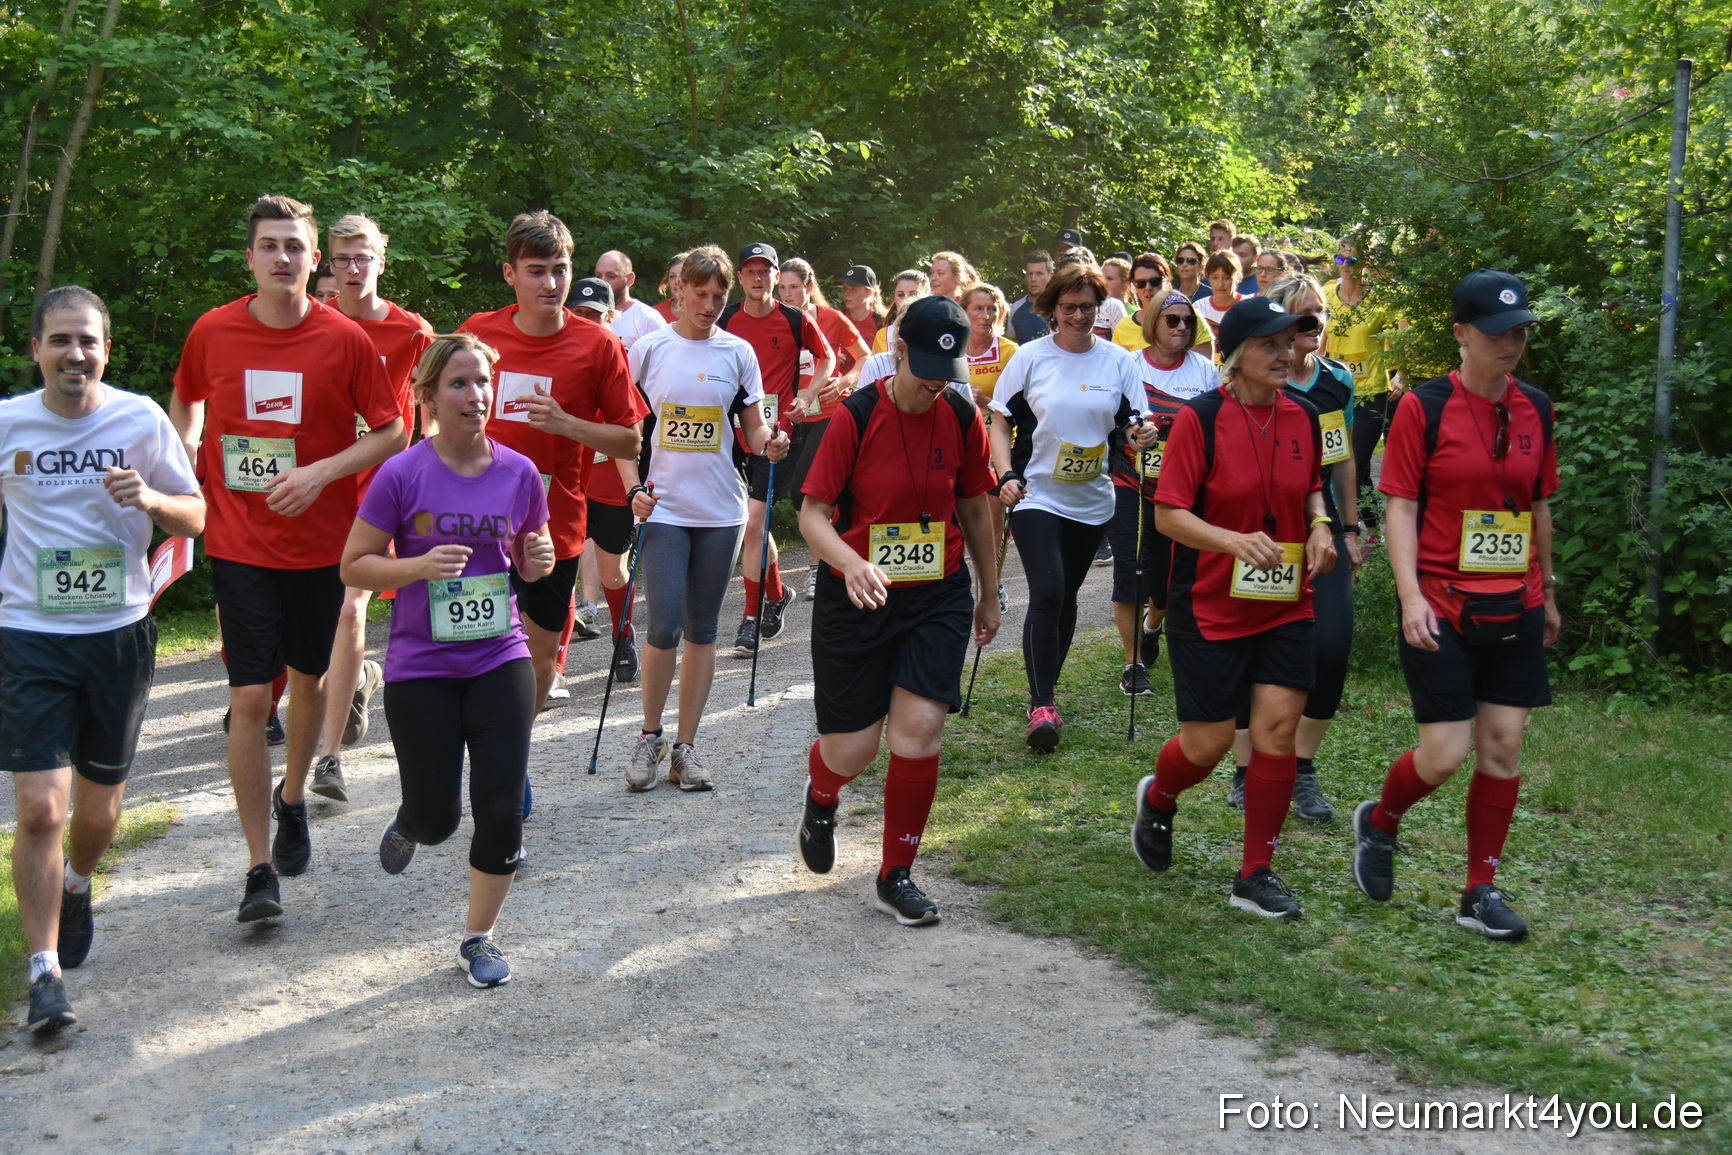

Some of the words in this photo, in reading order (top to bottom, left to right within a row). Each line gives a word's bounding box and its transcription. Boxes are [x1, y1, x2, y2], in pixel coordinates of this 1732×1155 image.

[975, 366, 1002, 375] BÖGL
[1347, 362, 1363, 373] 91
[266, 400, 284, 409] DEHN
[667, 420, 714, 439] 2379
[1518, 434, 1531, 449] 13
[934, 448, 943, 463] 3
[238, 456, 280, 477] 464
[1061, 457, 1100, 473] 2371
[1469, 532, 1523, 555] 2353
[878, 543, 935, 565] 2348
[55, 569, 107, 594] 942
[1241, 562, 1294, 585] 2364
[84, 591, 117, 600] Christoph
[448, 597, 495, 623] 939
